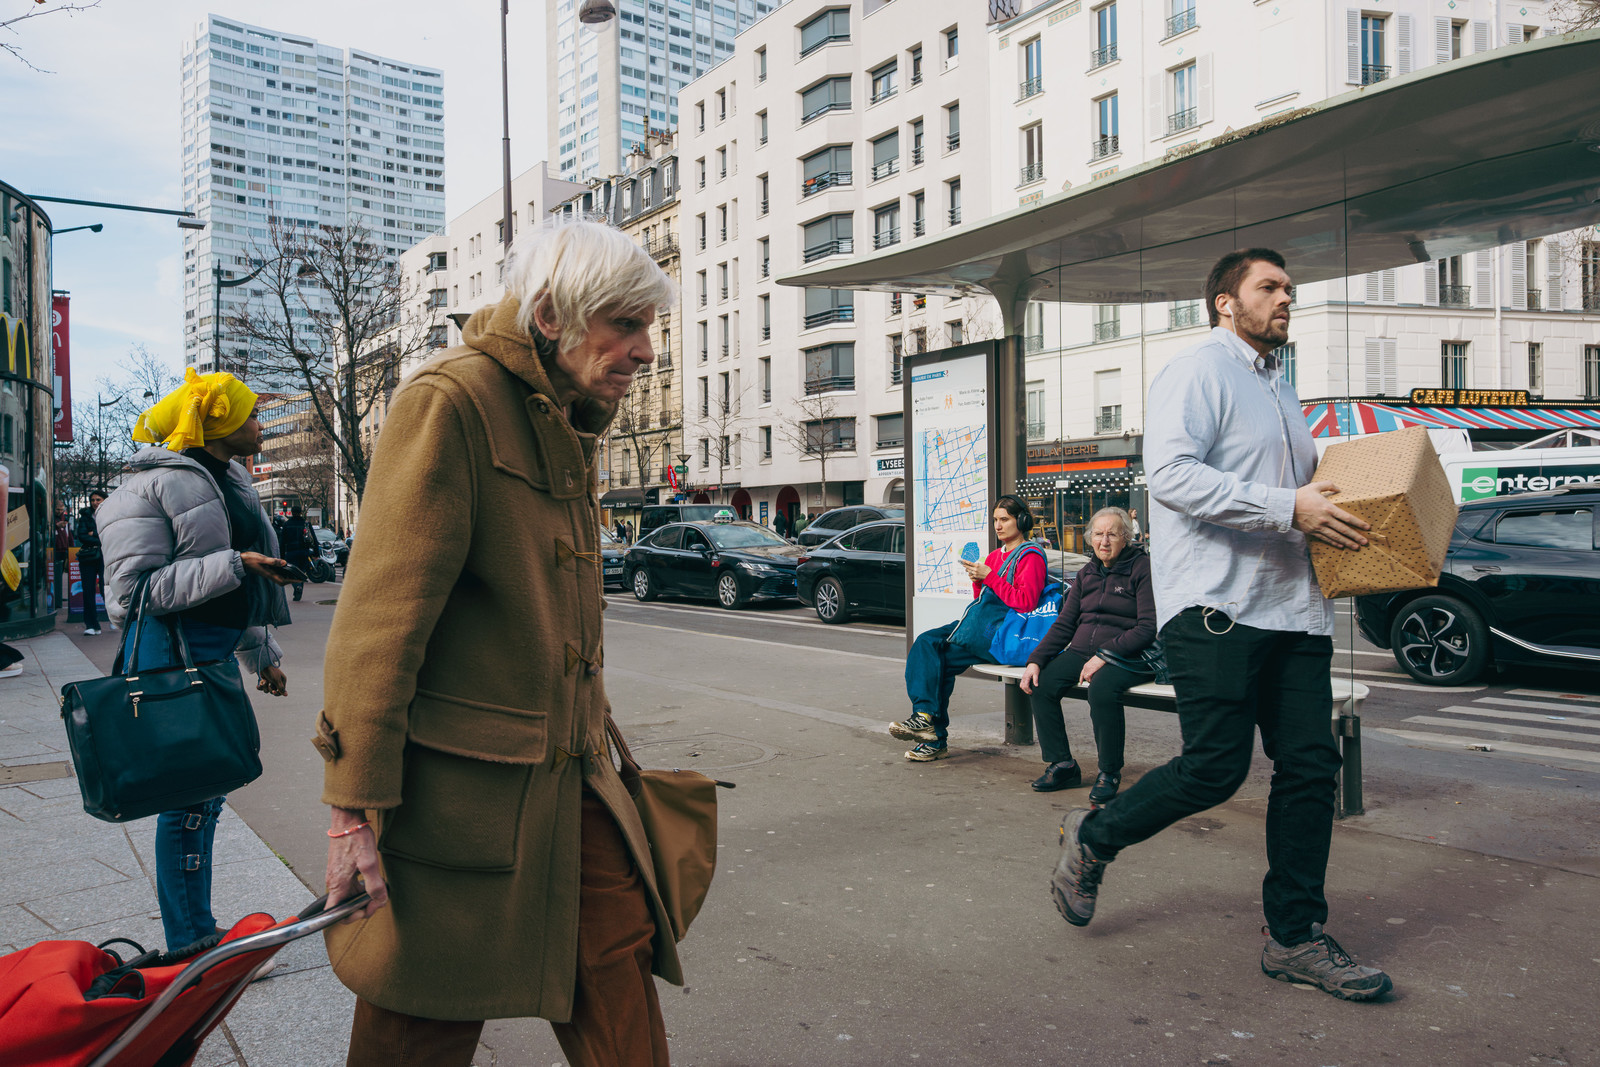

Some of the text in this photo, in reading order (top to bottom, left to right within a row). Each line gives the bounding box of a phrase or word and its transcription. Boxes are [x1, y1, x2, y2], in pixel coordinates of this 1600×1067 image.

[1412, 389, 1528, 406] CAFE LUTETIA
[1027, 444, 1099, 458] OULANGERIE
